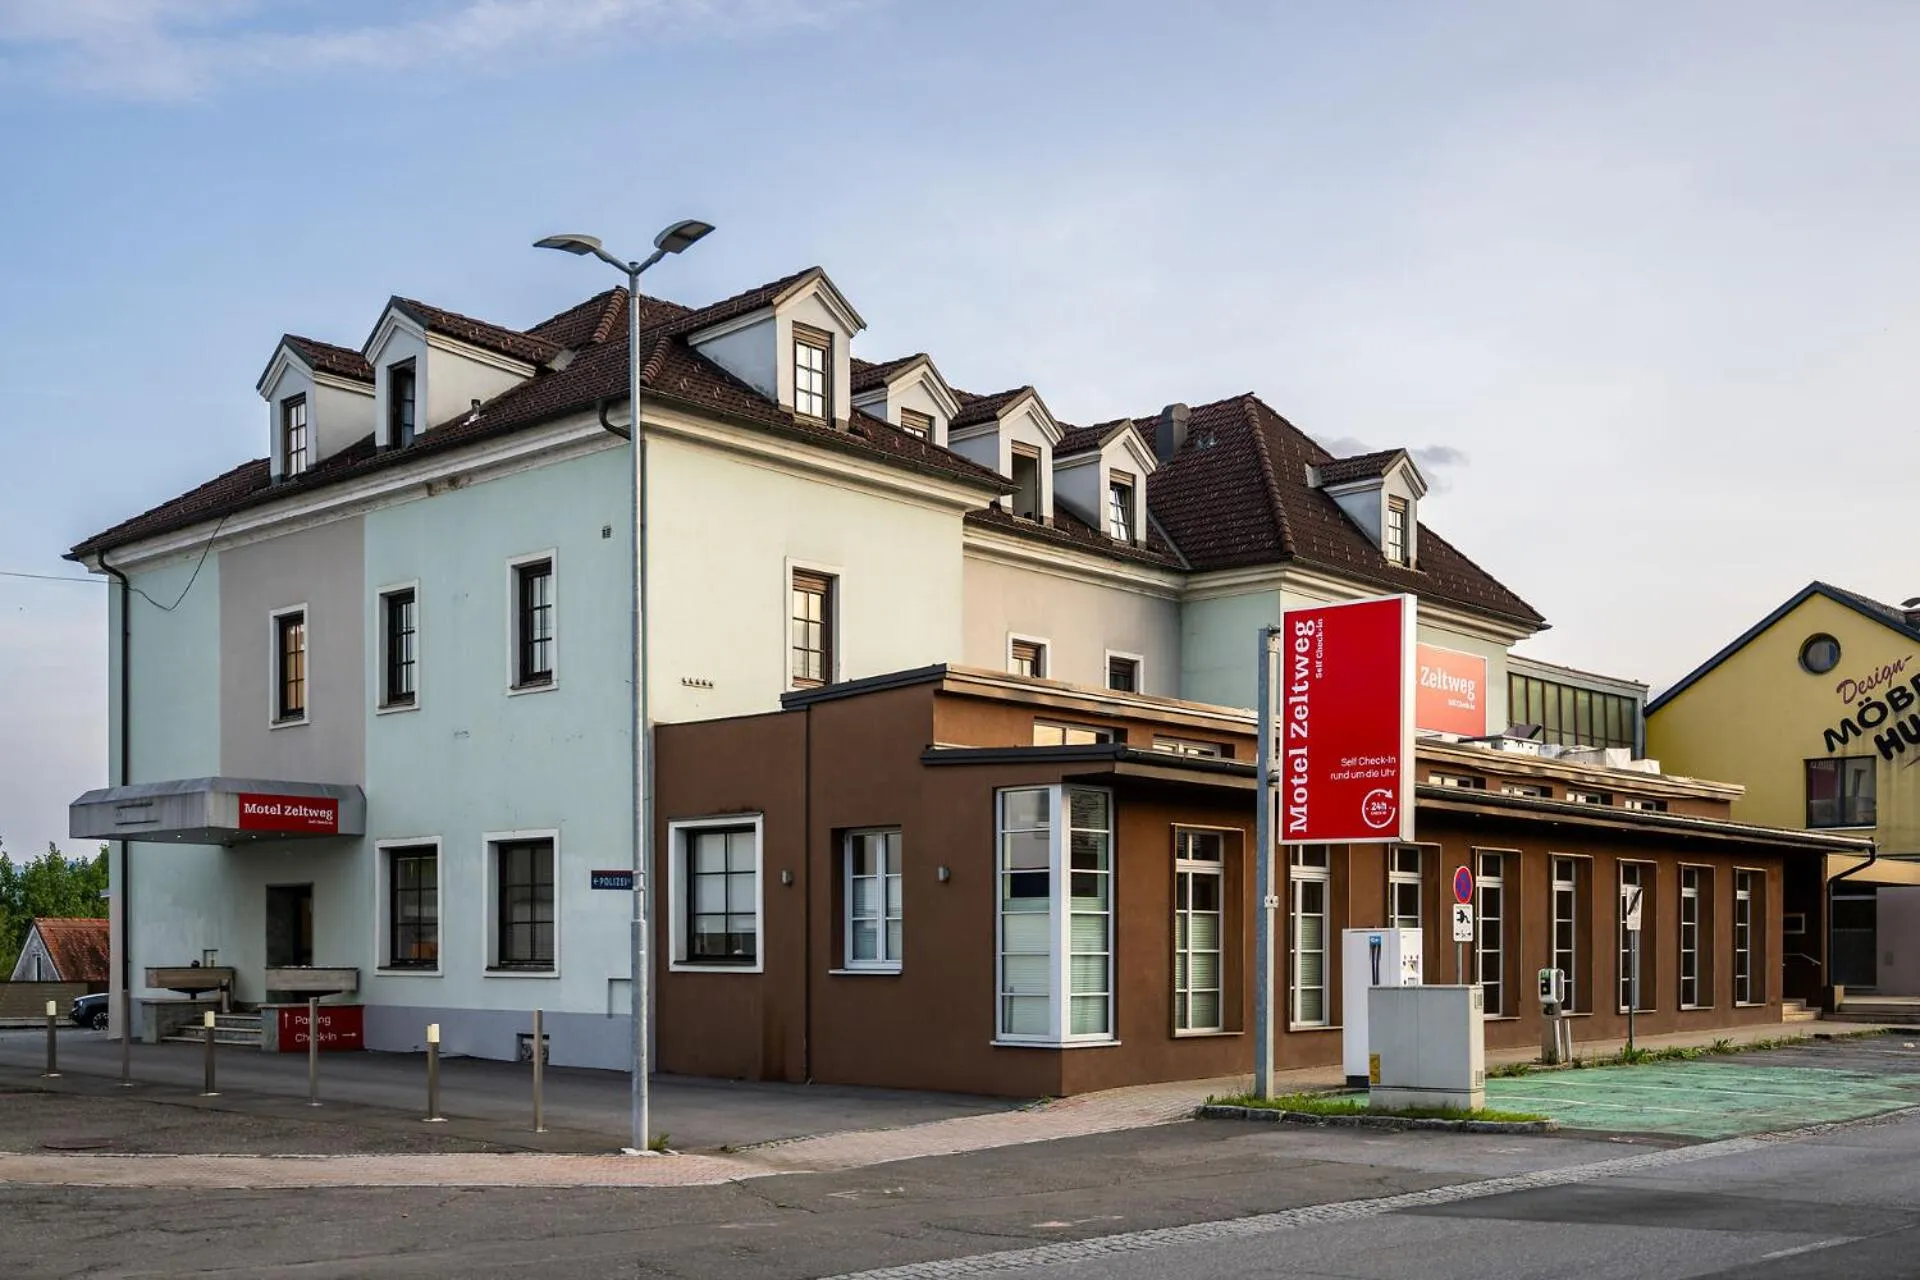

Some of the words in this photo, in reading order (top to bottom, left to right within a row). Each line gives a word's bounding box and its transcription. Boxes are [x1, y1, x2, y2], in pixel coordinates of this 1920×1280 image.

[1288, 619, 1316, 739] Zeltweg
[1315, 659, 1324, 679] Self
[1420, 665, 1476, 701] Zeltweg
[1836, 655, 1914, 705] Design-
[1330, 770, 1350, 781] rund
[1350, 771, 1365, 780] um
[1365, 769, 1379, 779] die
[1380, 767, 1397, 778] Uhr
[1340, 757, 1358, 768] Self
[1358, 754, 1397, 767] Check-In
[1288, 745, 1309, 833] Motel
[243, 803, 282, 815] Motel
[284, 805, 334, 821] Zeltweg
